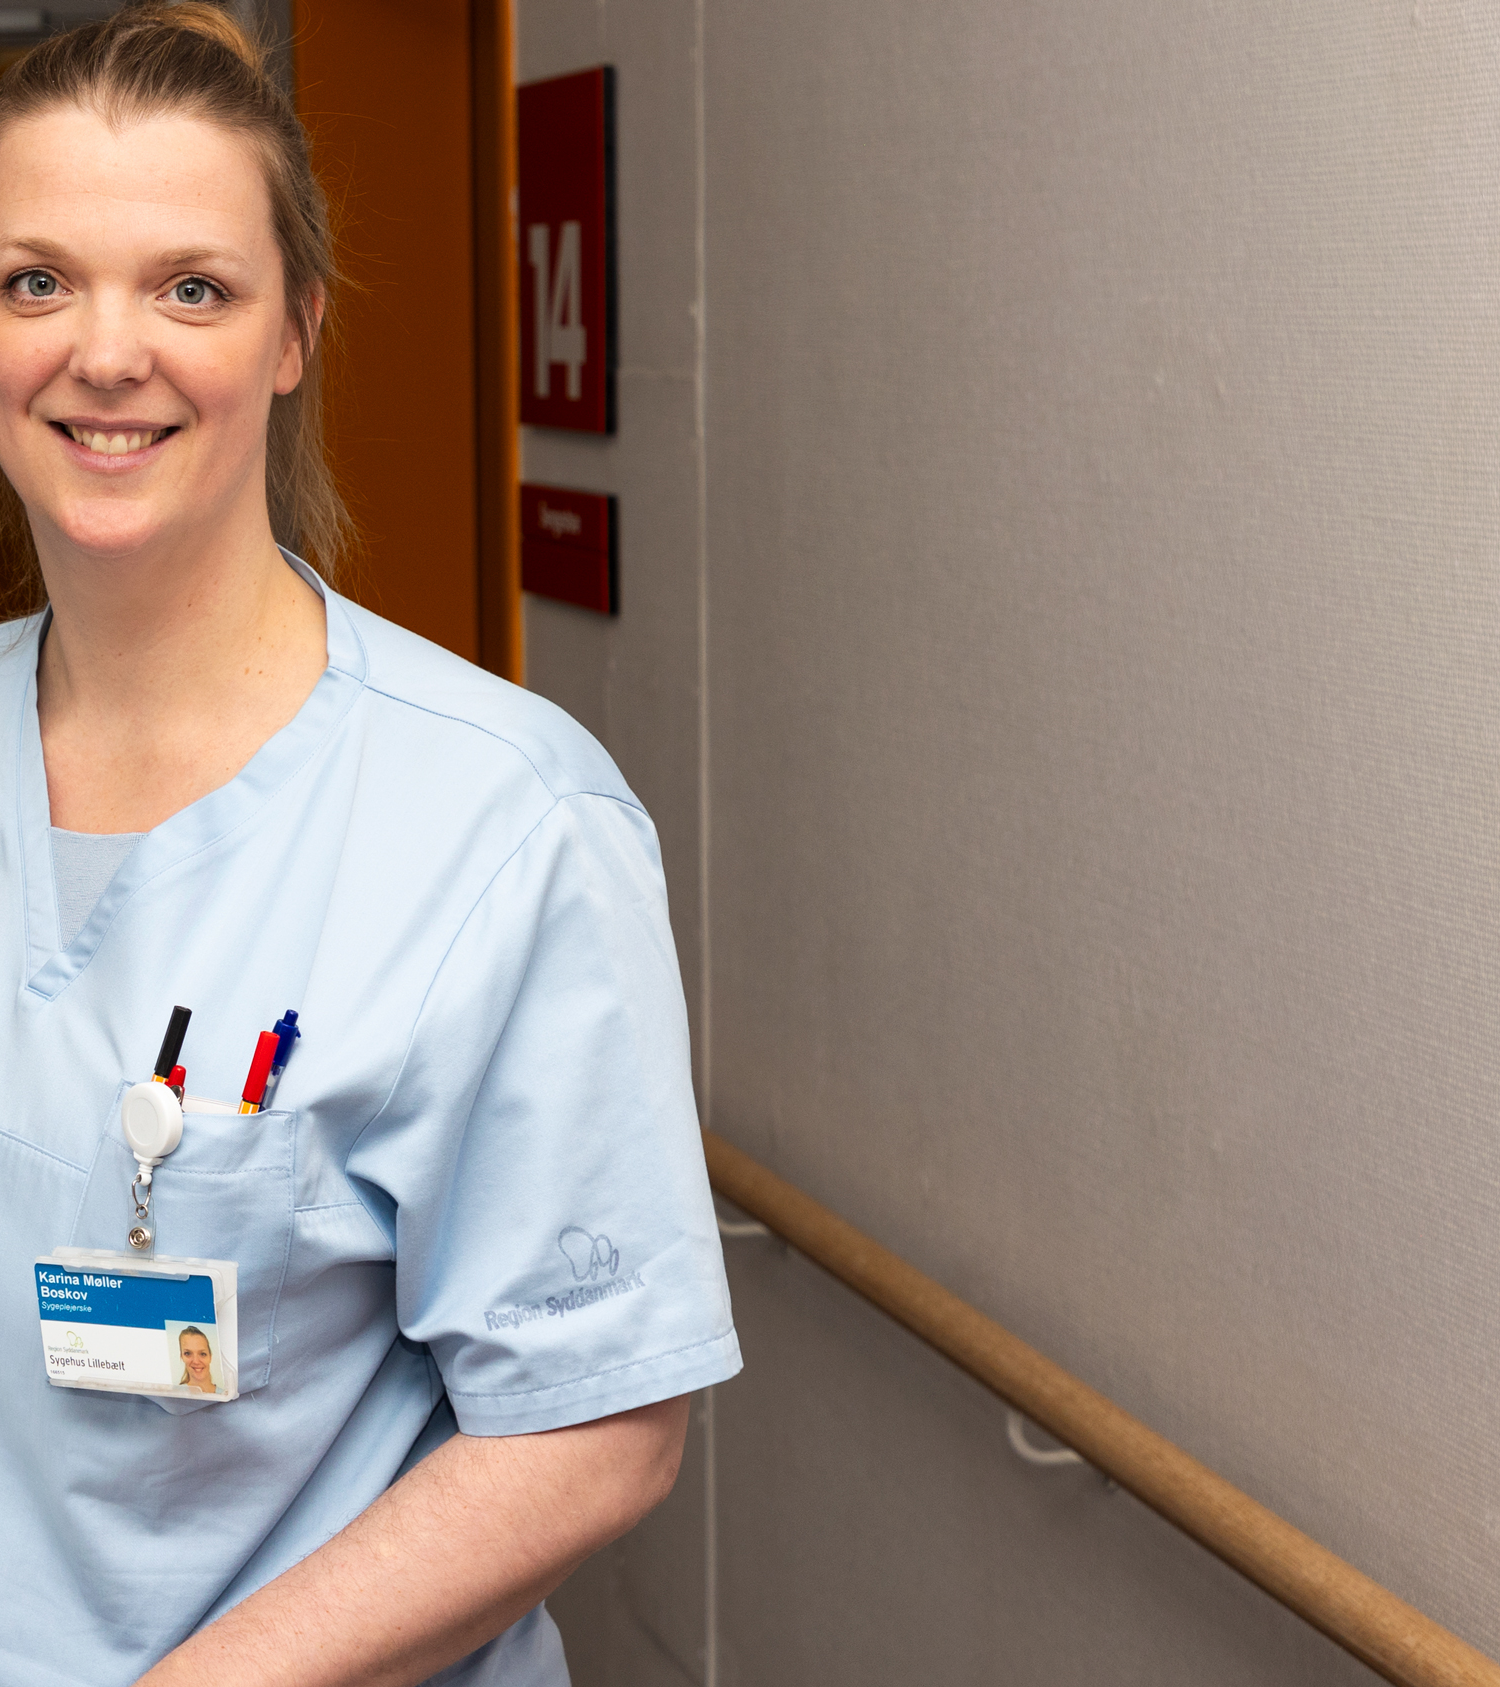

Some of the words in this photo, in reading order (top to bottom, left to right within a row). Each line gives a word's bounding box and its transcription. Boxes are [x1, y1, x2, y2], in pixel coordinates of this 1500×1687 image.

[528, 220, 587, 400] 14
[38, 1271, 80, 1286] Karina
[83, 1274, 123, 1288] Møller
[40, 1286, 88, 1300] Boskov
[483, 1303, 543, 1331] Region
[545, 1270, 646, 1318] Syddanmark
[41, 1301, 92, 1313] Sygeplejerske
[49, 1354, 86, 1367] Sygehus
[87, 1358, 126, 1371] Lillebælt
